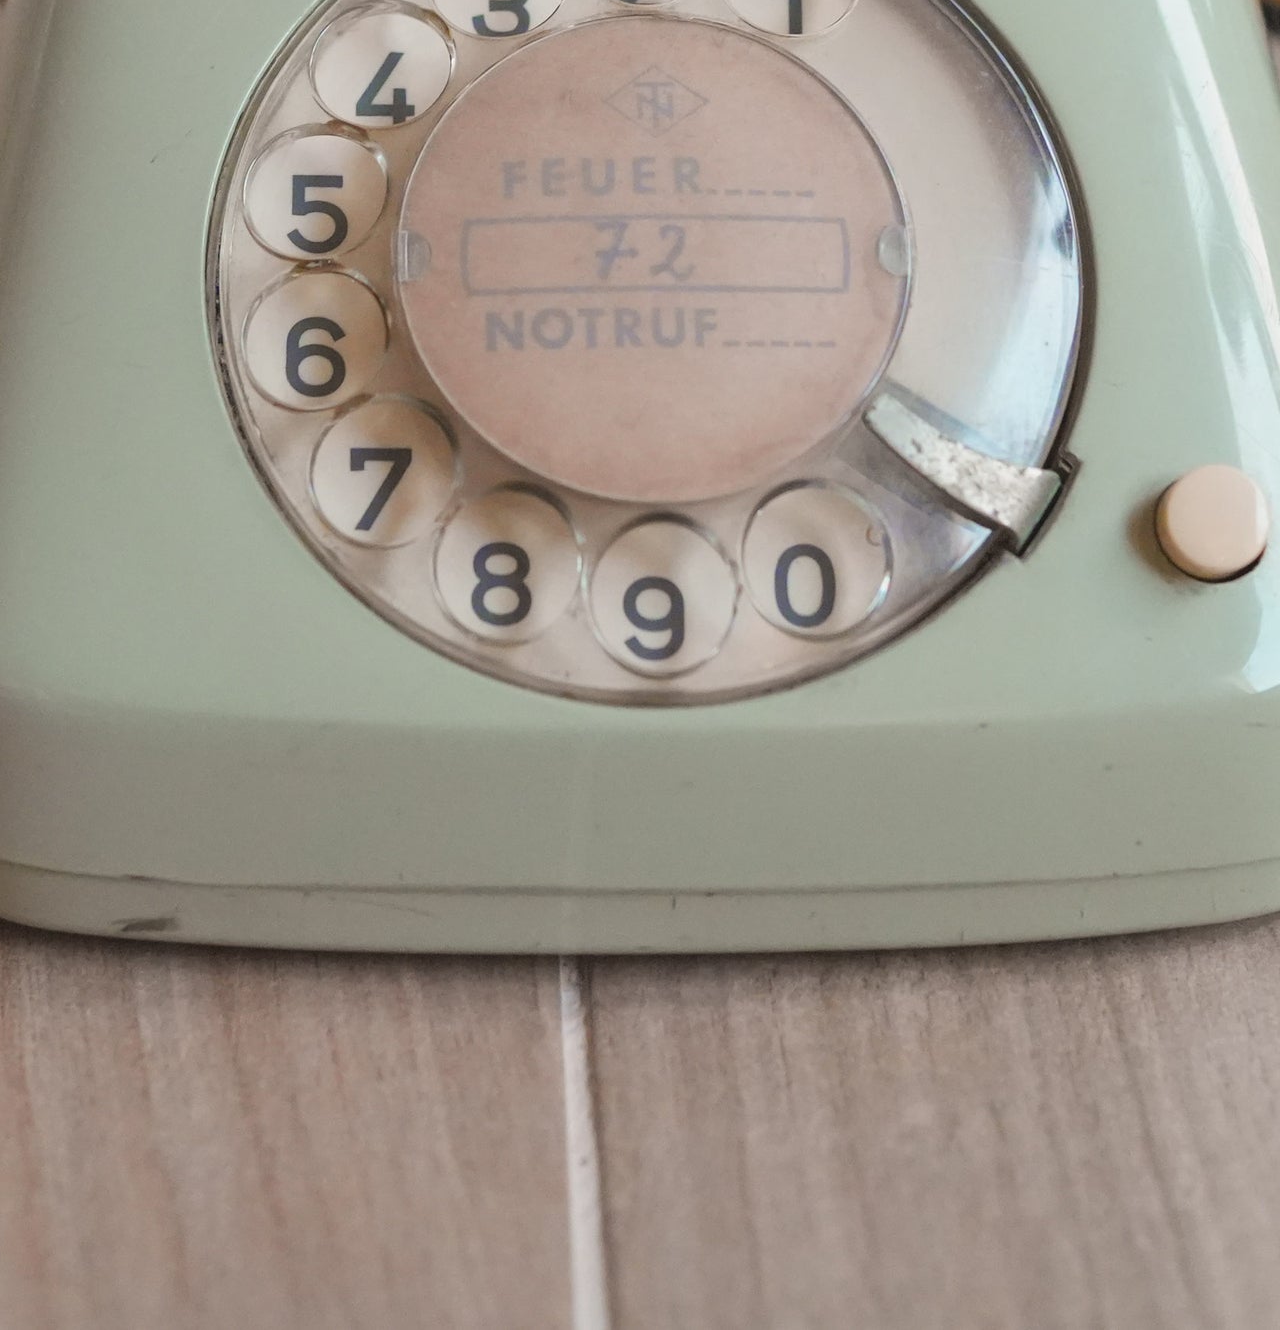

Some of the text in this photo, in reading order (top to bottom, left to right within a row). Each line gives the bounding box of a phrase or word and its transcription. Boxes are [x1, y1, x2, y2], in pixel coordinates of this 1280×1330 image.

[355, 52, 415, 123] 4
[287, 175, 348, 254] 5
[501, 156, 702, 198] FEUER
[594, 222, 696, 281] 72
[285, 317, 346, 397] 6
[484, 307, 718, 352] NOTRUF
[349, 448, 412, 531] 7
[471, 541, 532, 626] 8
[622, 576, 685, 660] 9
[774, 543, 835, 627] 0
